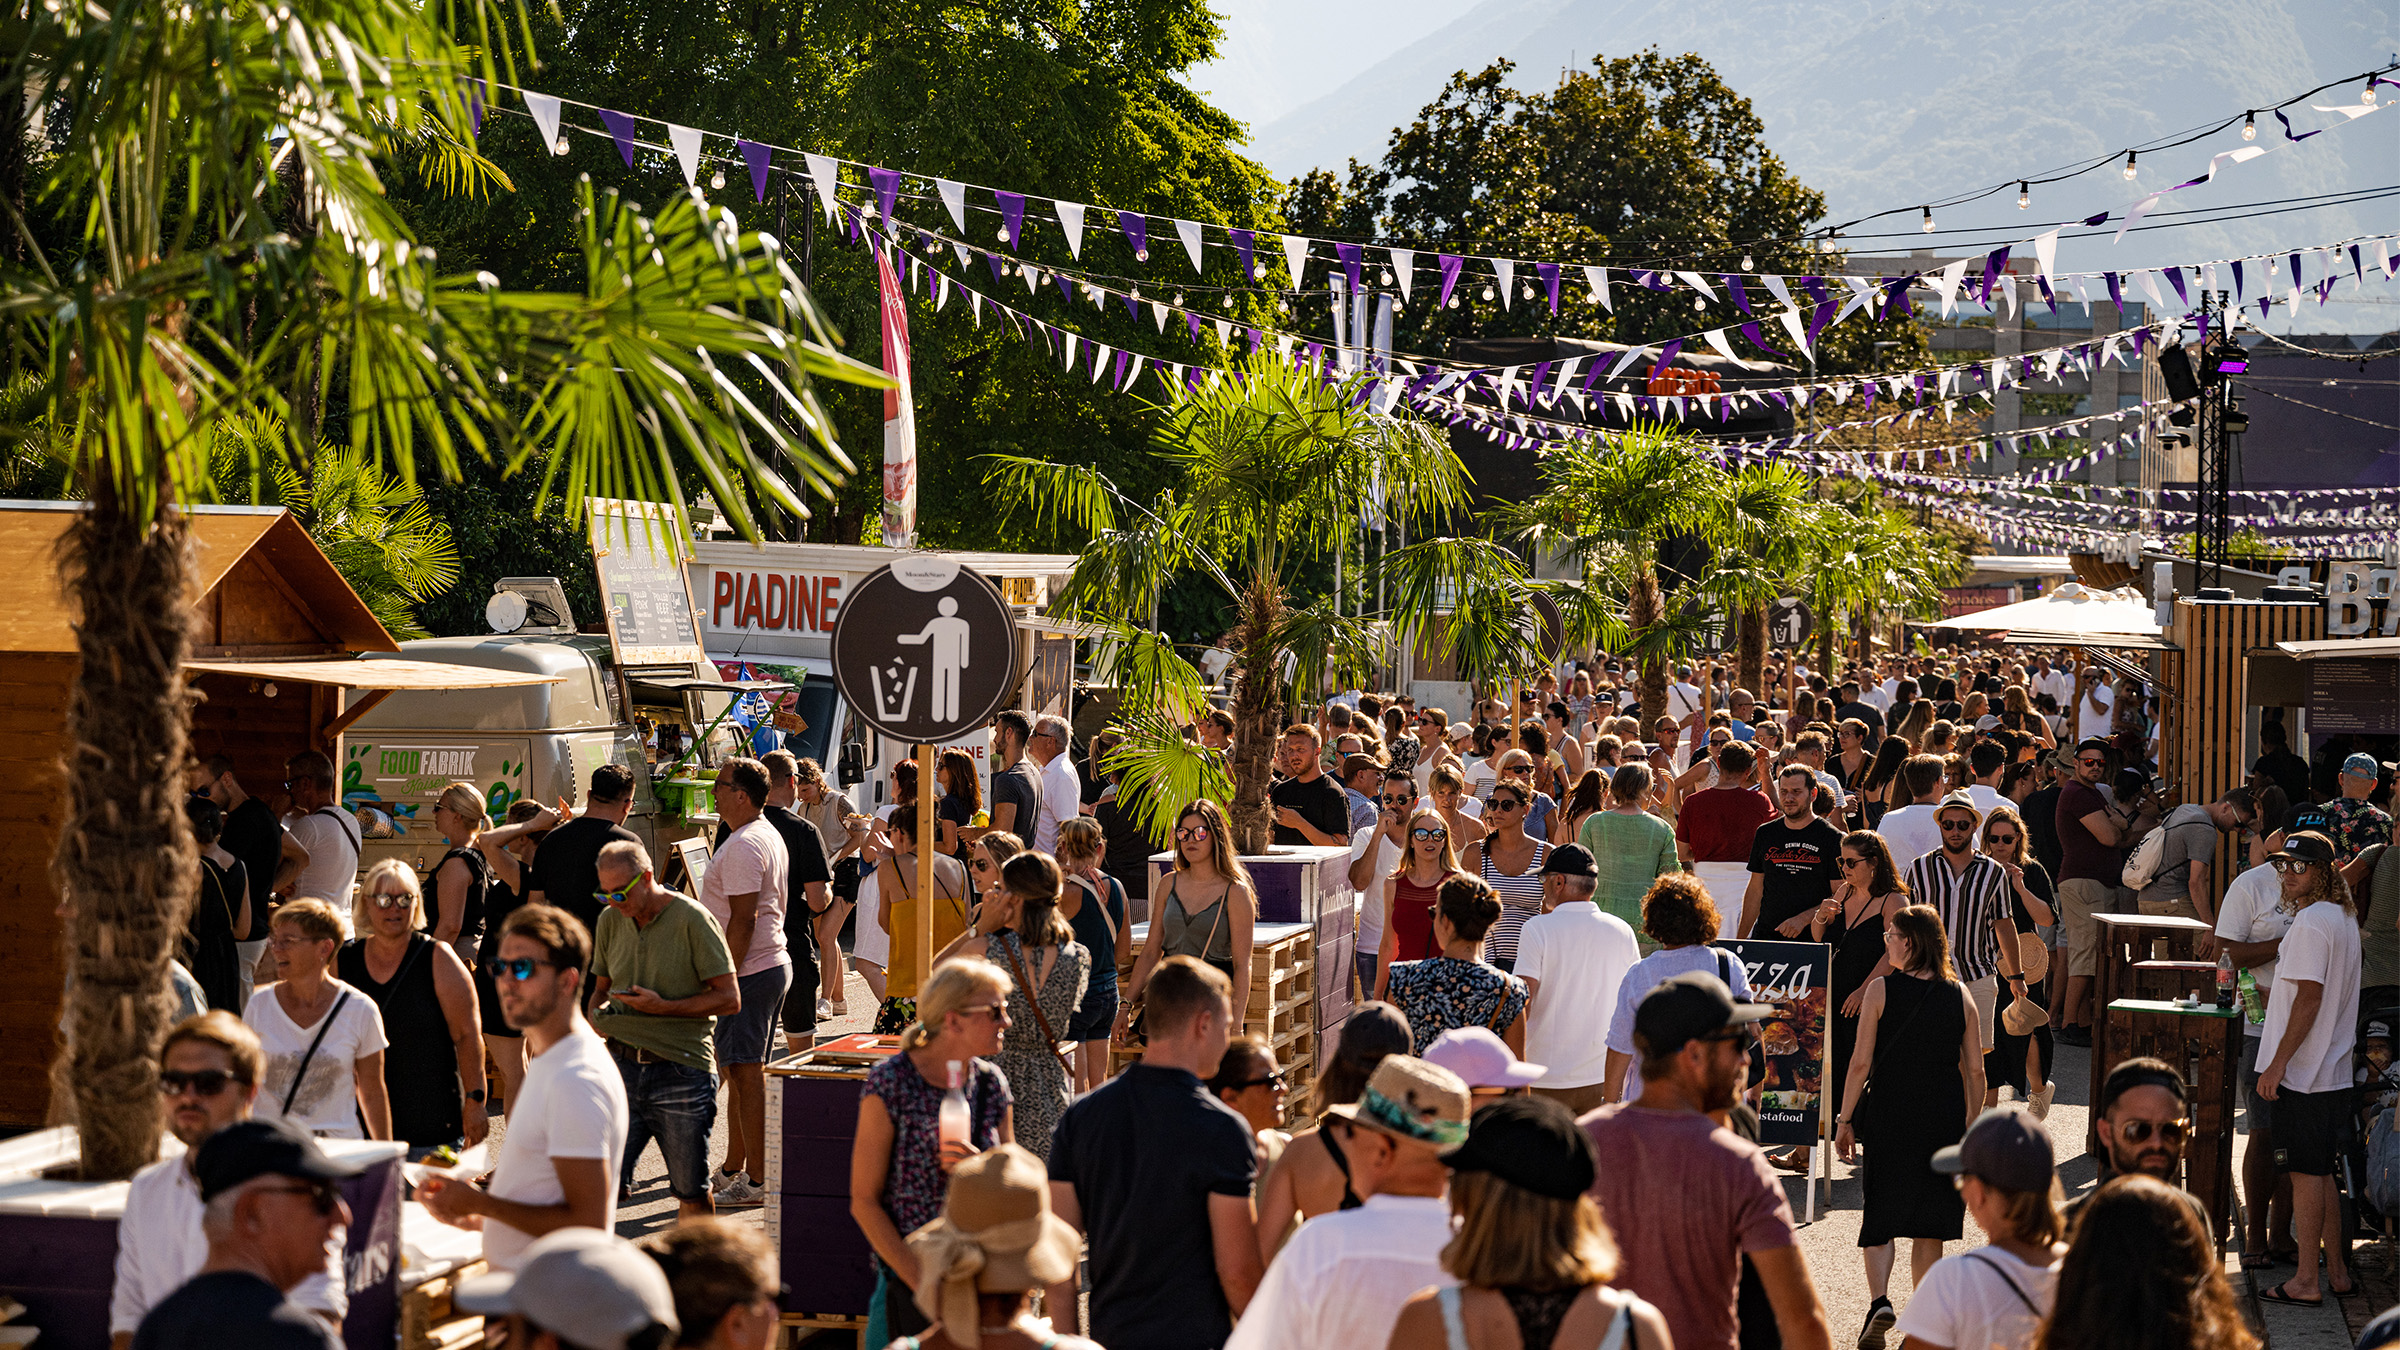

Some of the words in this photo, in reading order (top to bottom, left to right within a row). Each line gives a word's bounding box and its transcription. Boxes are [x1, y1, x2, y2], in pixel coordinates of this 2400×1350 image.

[713, 571, 840, 632] PIADINE
[379, 750, 476, 776] FOODFABRIK
[400, 777, 447, 797] Kaiser
[1802, 843, 1819, 852] GOODS
